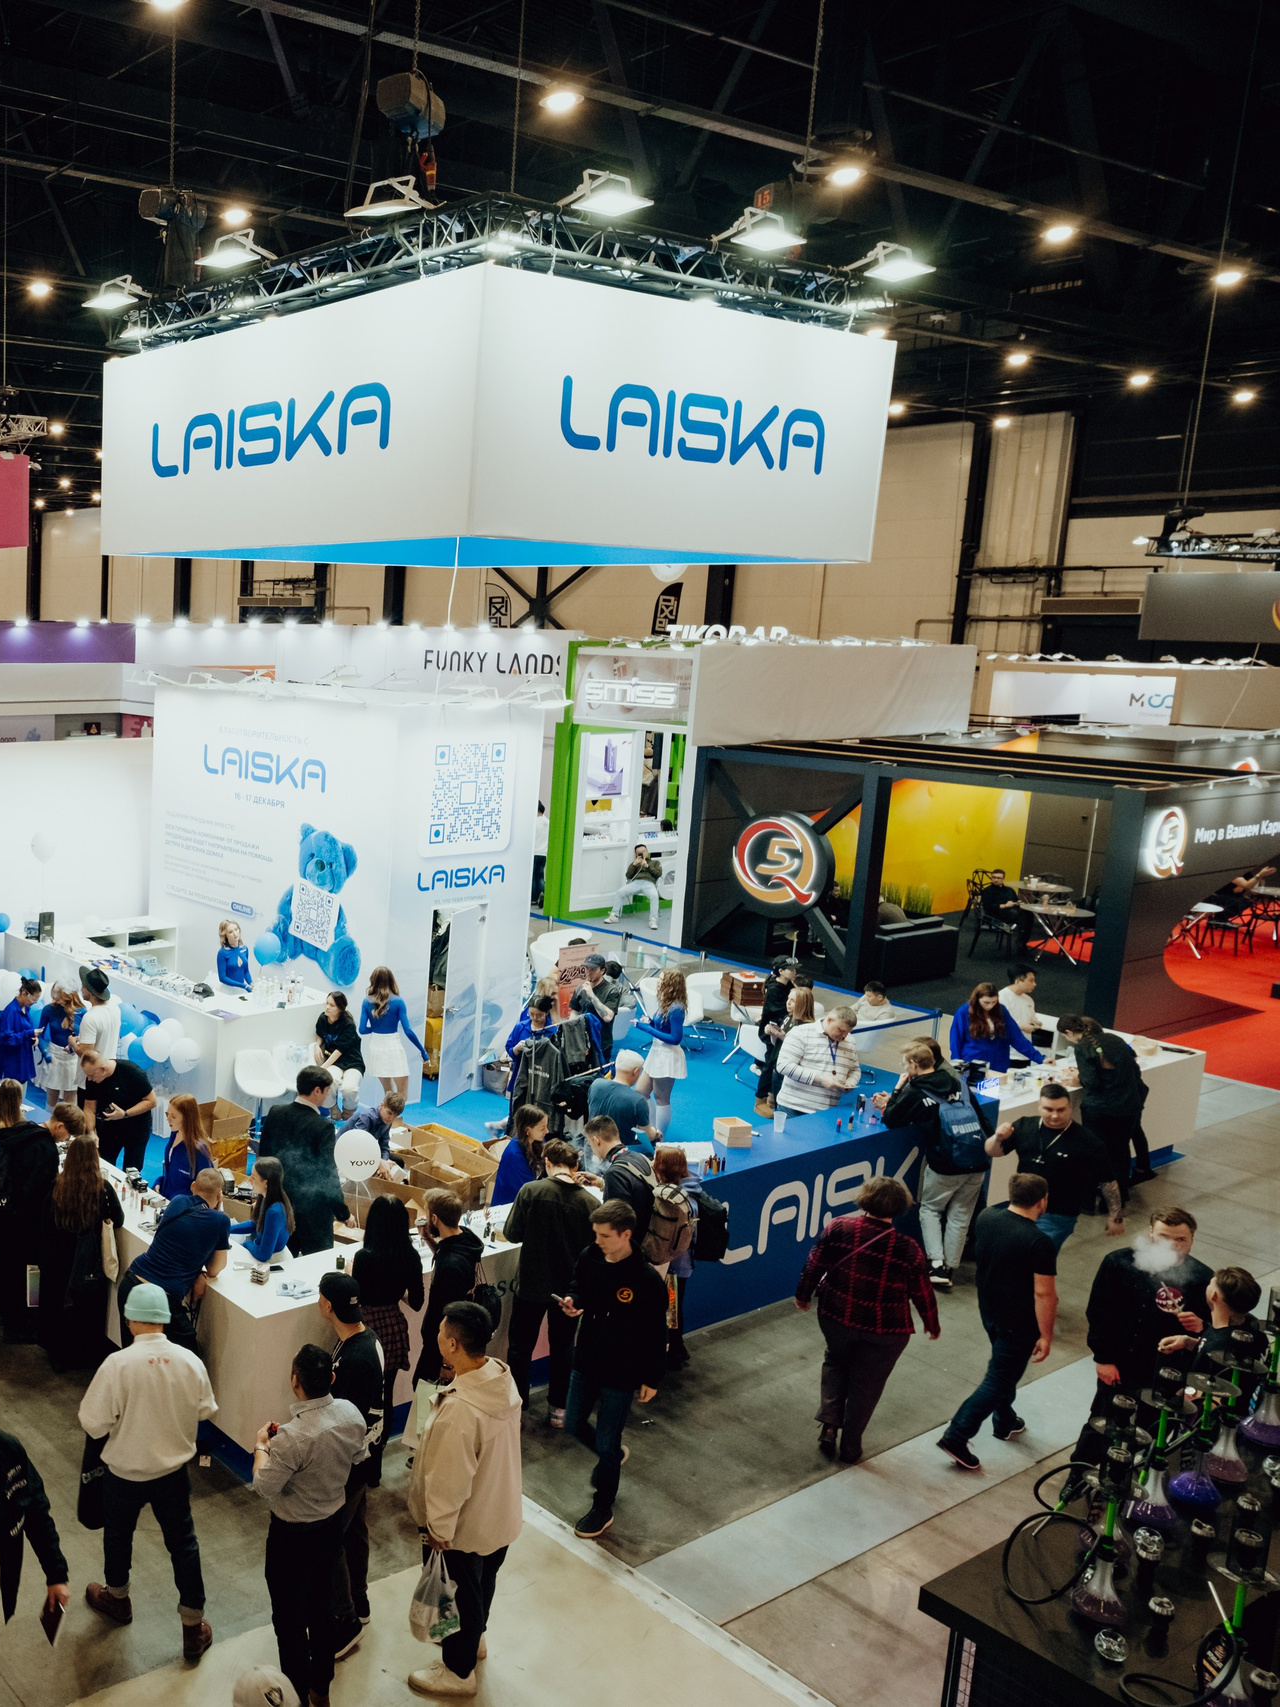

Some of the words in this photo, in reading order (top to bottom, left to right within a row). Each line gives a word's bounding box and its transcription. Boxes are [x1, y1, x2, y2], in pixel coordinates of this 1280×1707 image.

[152, 382, 390, 477] LAISKA
[561, 375, 825, 475] LAISKA
[424, 650, 488, 673] FUNKY
[219, 726, 302, 744] БЛАГОТВОРИТЕЛЬНОСТЬ
[204, 744, 326, 793] LAISKA
[253, 796, 285, 808] ДЕКАБРЯ
[1194, 827, 1217, 844] Мир
[1225, 824, 1259, 840] Вашем
[417, 864, 505, 891] LAISKA
[951, 1122, 980, 1134] PUMA
